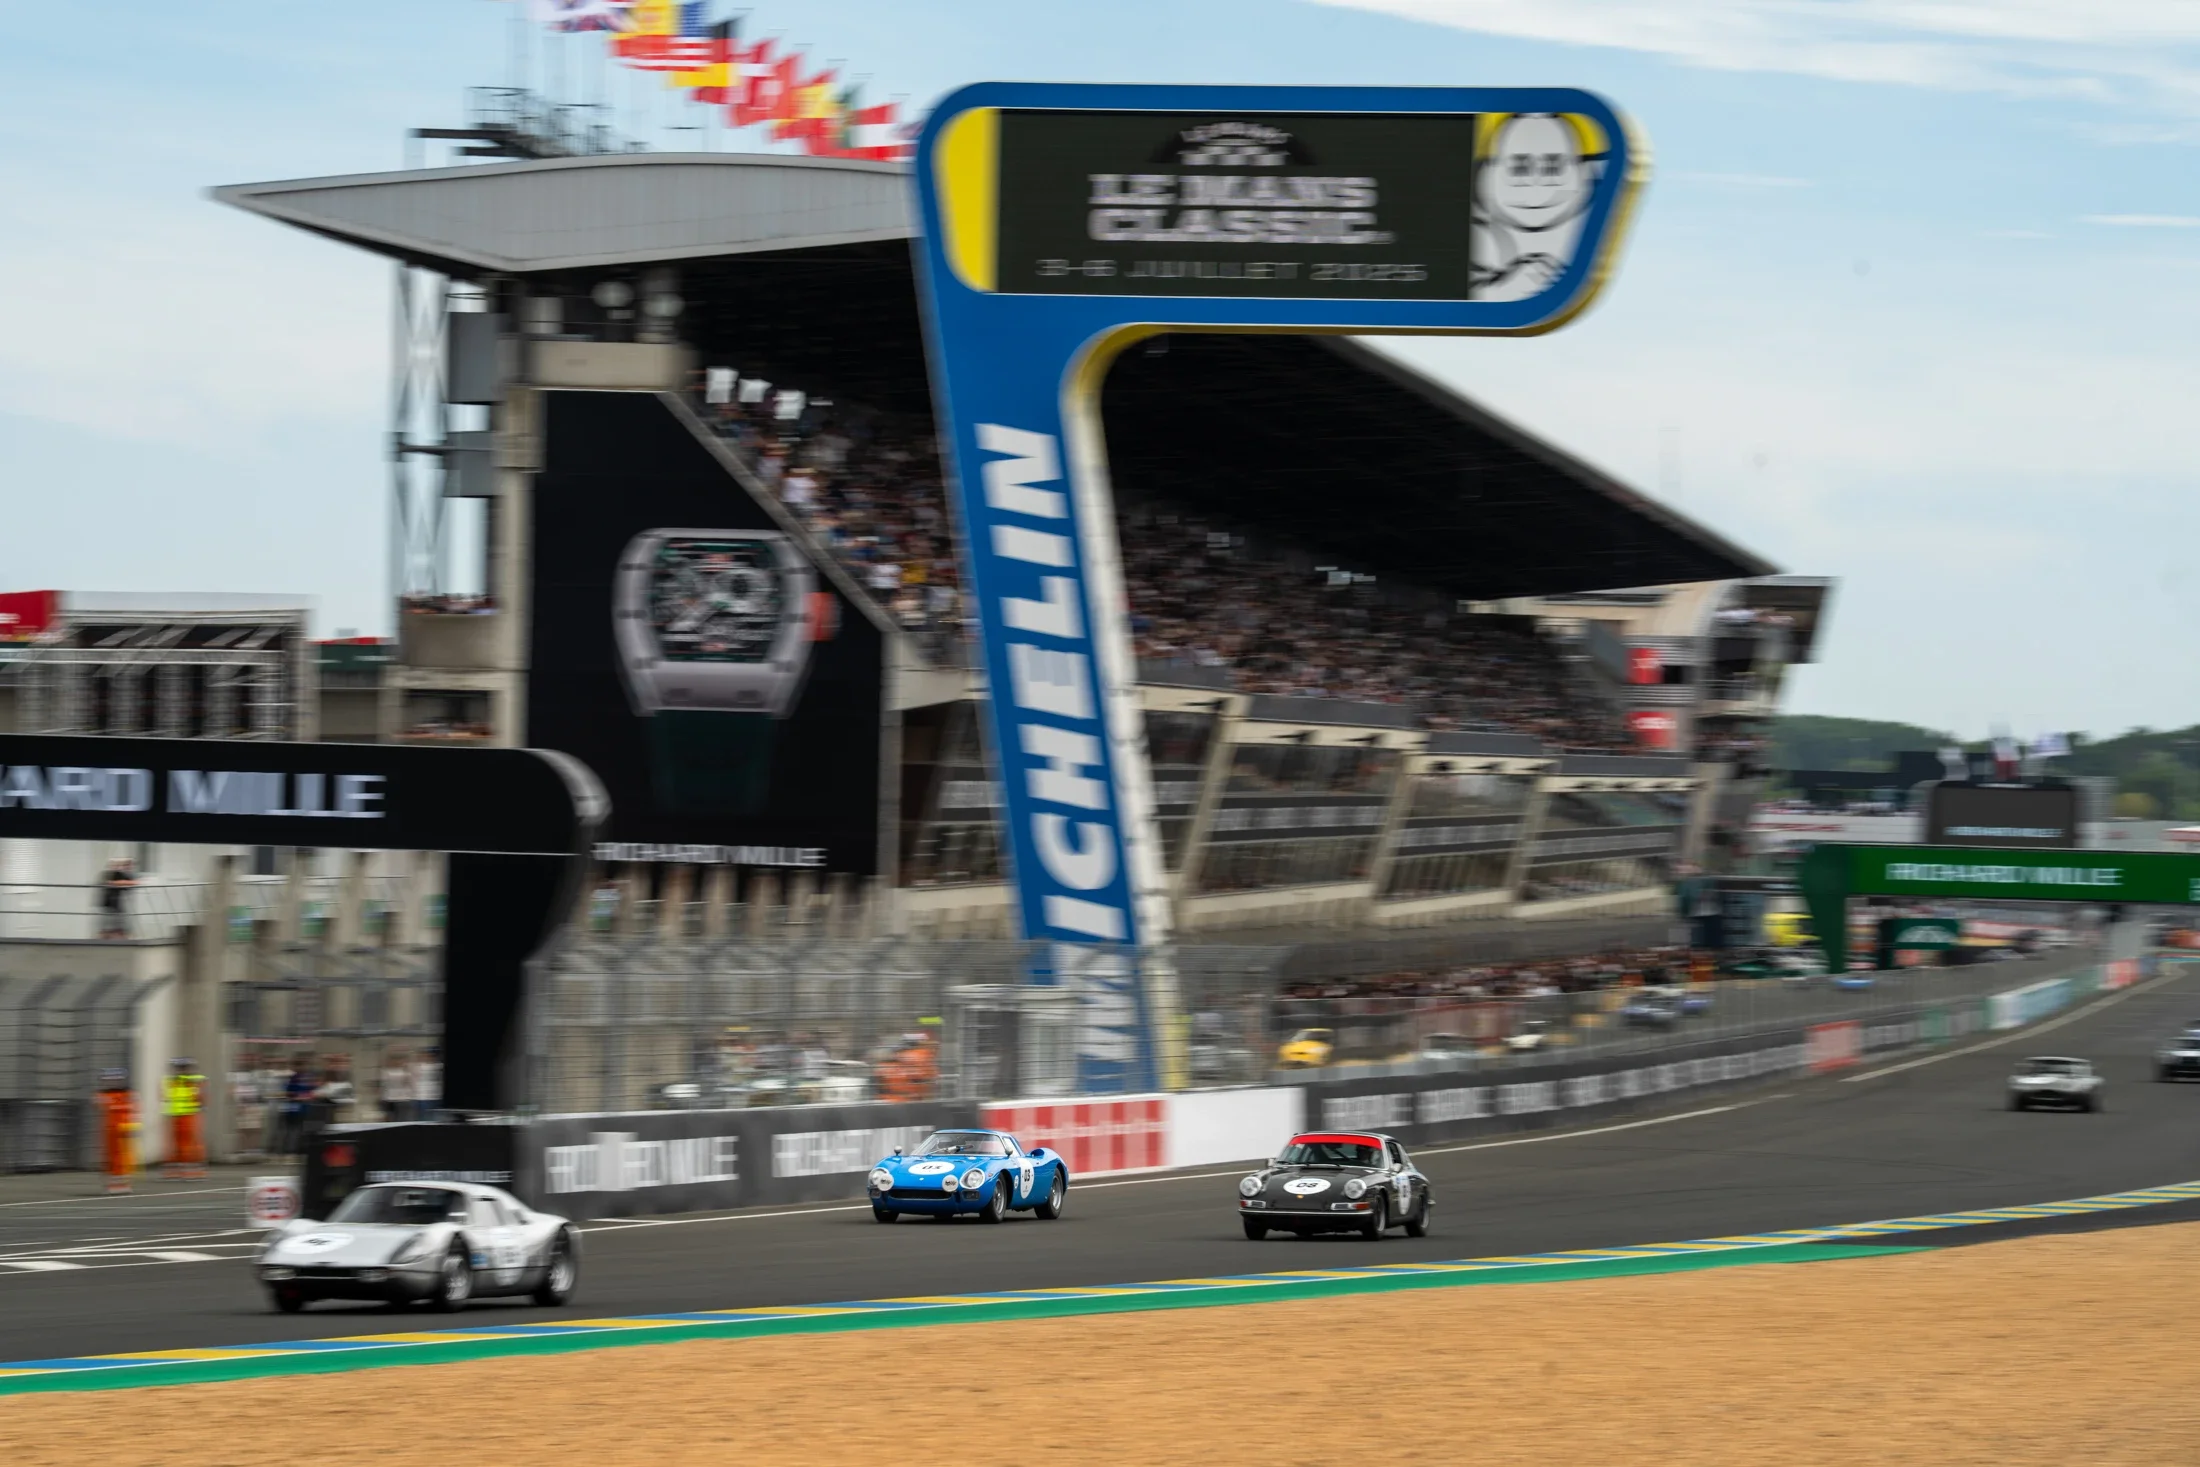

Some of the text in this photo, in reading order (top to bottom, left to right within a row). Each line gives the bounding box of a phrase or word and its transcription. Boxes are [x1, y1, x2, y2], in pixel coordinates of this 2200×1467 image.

[1087, 174, 1379, 207] LE MANS
[1086, 208, 1382, 244] CLASSIC
[974, 422, 1139, 1062] MICHELIN
[0, 764, 387, 818] ARD MILLE
